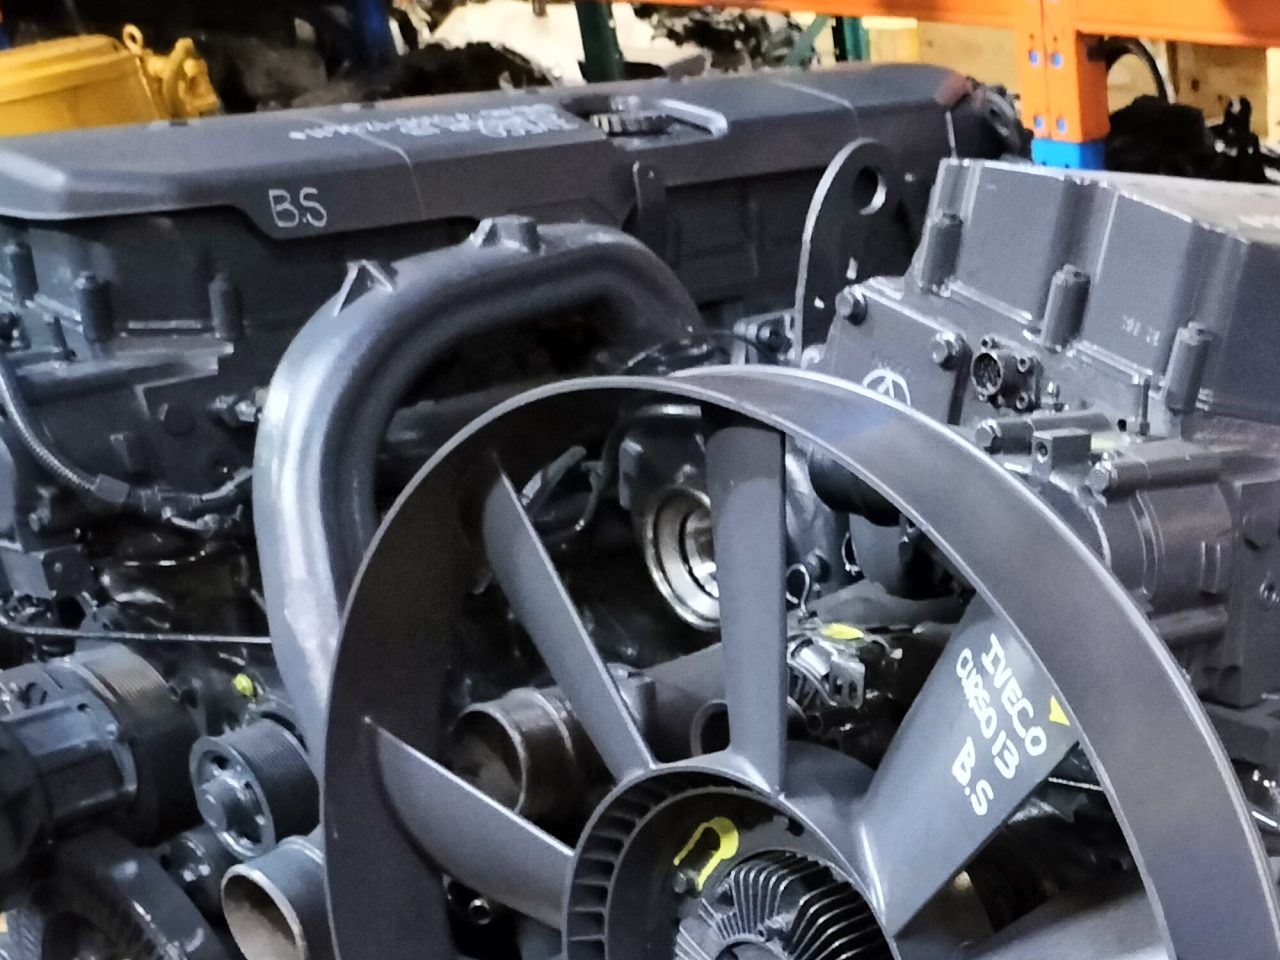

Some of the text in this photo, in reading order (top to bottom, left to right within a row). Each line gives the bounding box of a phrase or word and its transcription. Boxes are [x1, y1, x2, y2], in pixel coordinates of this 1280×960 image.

[956, 647, 1020, 779] CURSO 13
[981, 632, 1048, 757] IVECO
